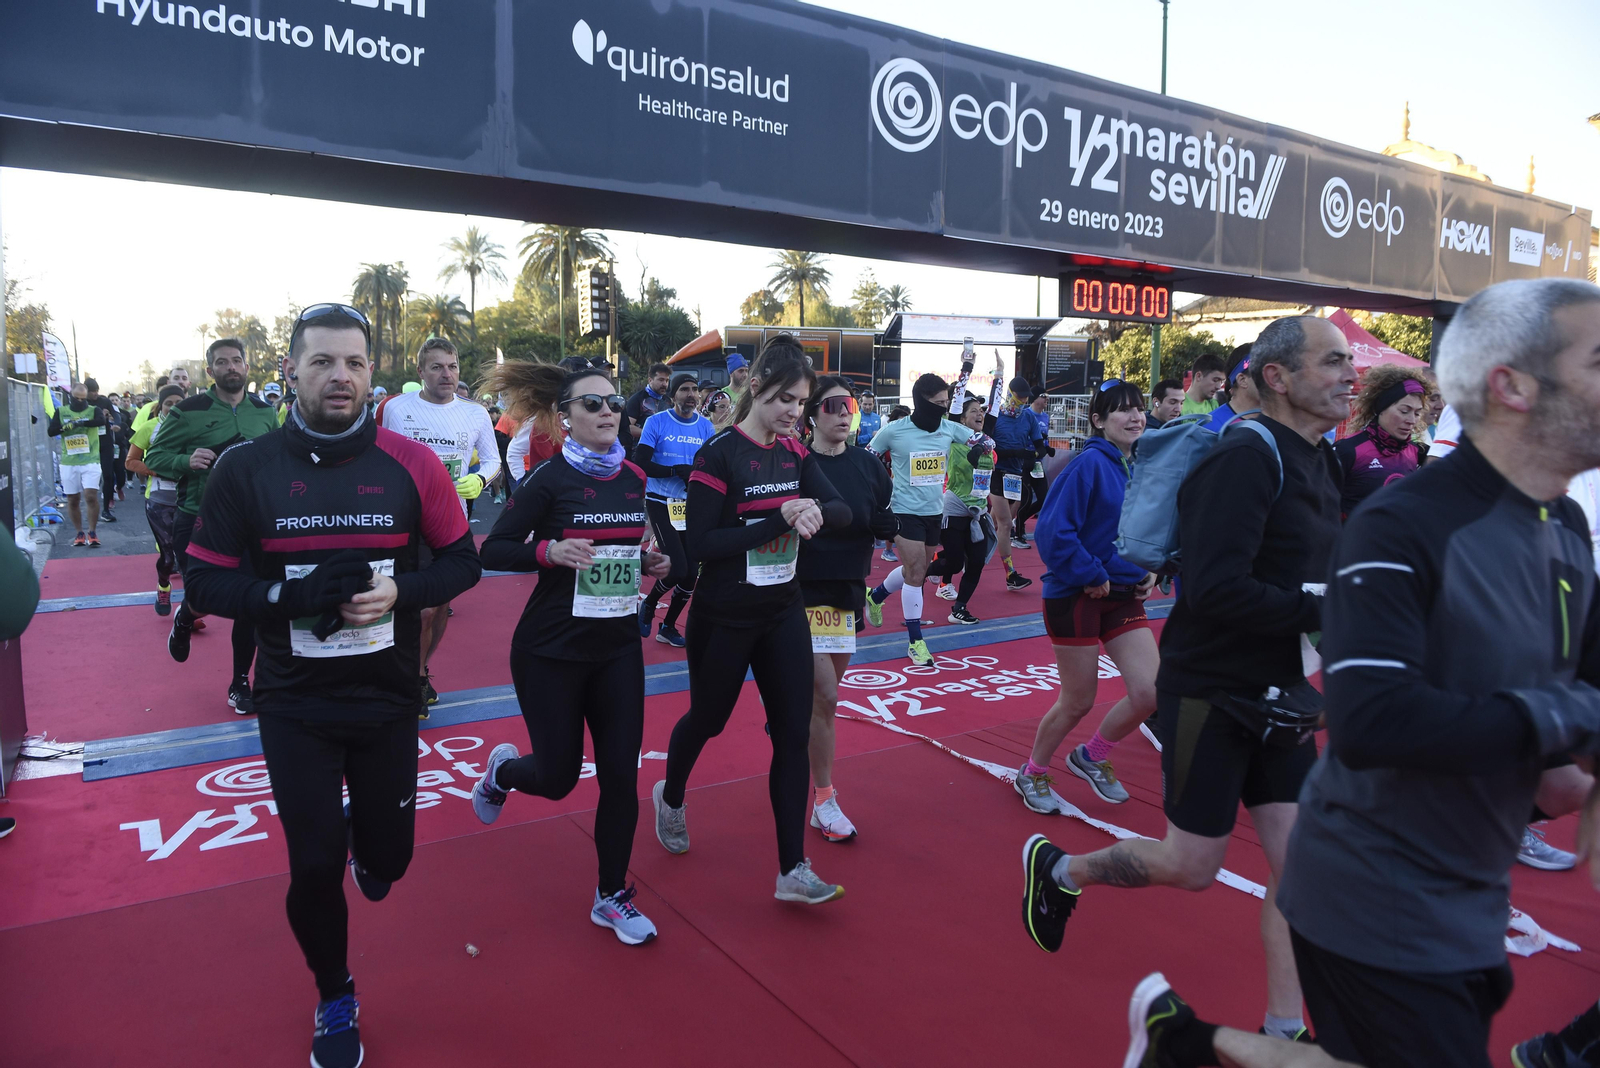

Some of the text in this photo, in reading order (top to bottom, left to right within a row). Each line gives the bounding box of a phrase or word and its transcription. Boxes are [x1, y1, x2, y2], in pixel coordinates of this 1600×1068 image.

[324, 25, 425, 67] Motor
[639, 93, 789, 137] Healthcare Partner
[949, 82, 1048, 168] edp
[1111, 116, 1256, 181] maratón
[1040, 198, 1164, 239] 29 enero 2023
[1356, 189, 1405, 247] edp
[1440, 218, 1491, 256] HOKA
[916, 459, 938, 471] 8023
[275, 514, 394, 531] PRORUNNERS
[590, 563, 631, 585] 5125
[342, 630, 360, 639] edp
[806, 610, 841, 627] 7909
